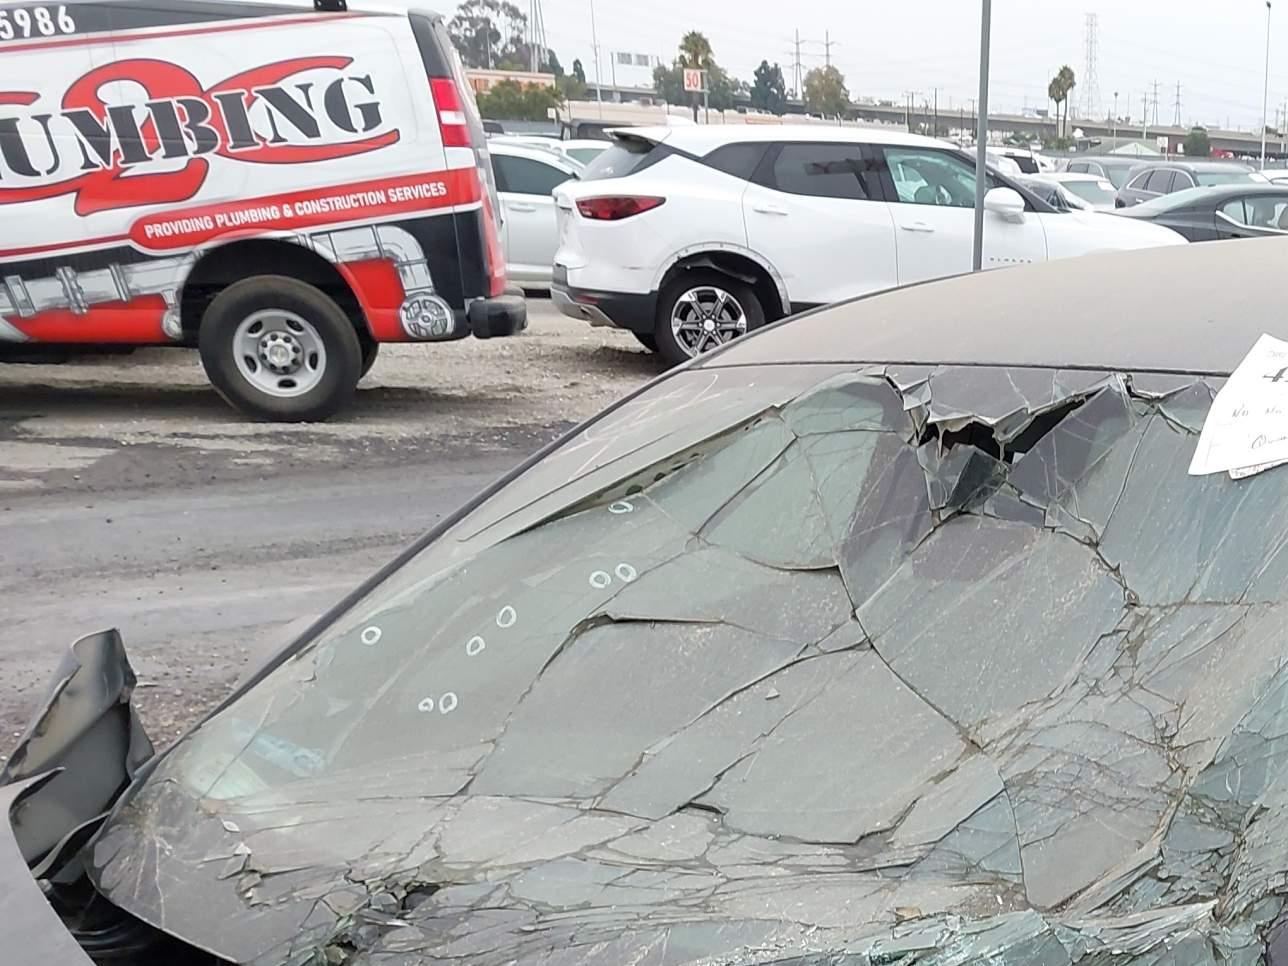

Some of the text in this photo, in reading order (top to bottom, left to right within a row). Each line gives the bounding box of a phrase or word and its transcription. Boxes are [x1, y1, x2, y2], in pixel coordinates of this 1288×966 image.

[0, 6, 76, 40] 5986
[0, 74, 384, 177] UMBING
[144, 181, 447, 239] PROVIDING PLUMBING & CONSTRUCTION SERVICES
